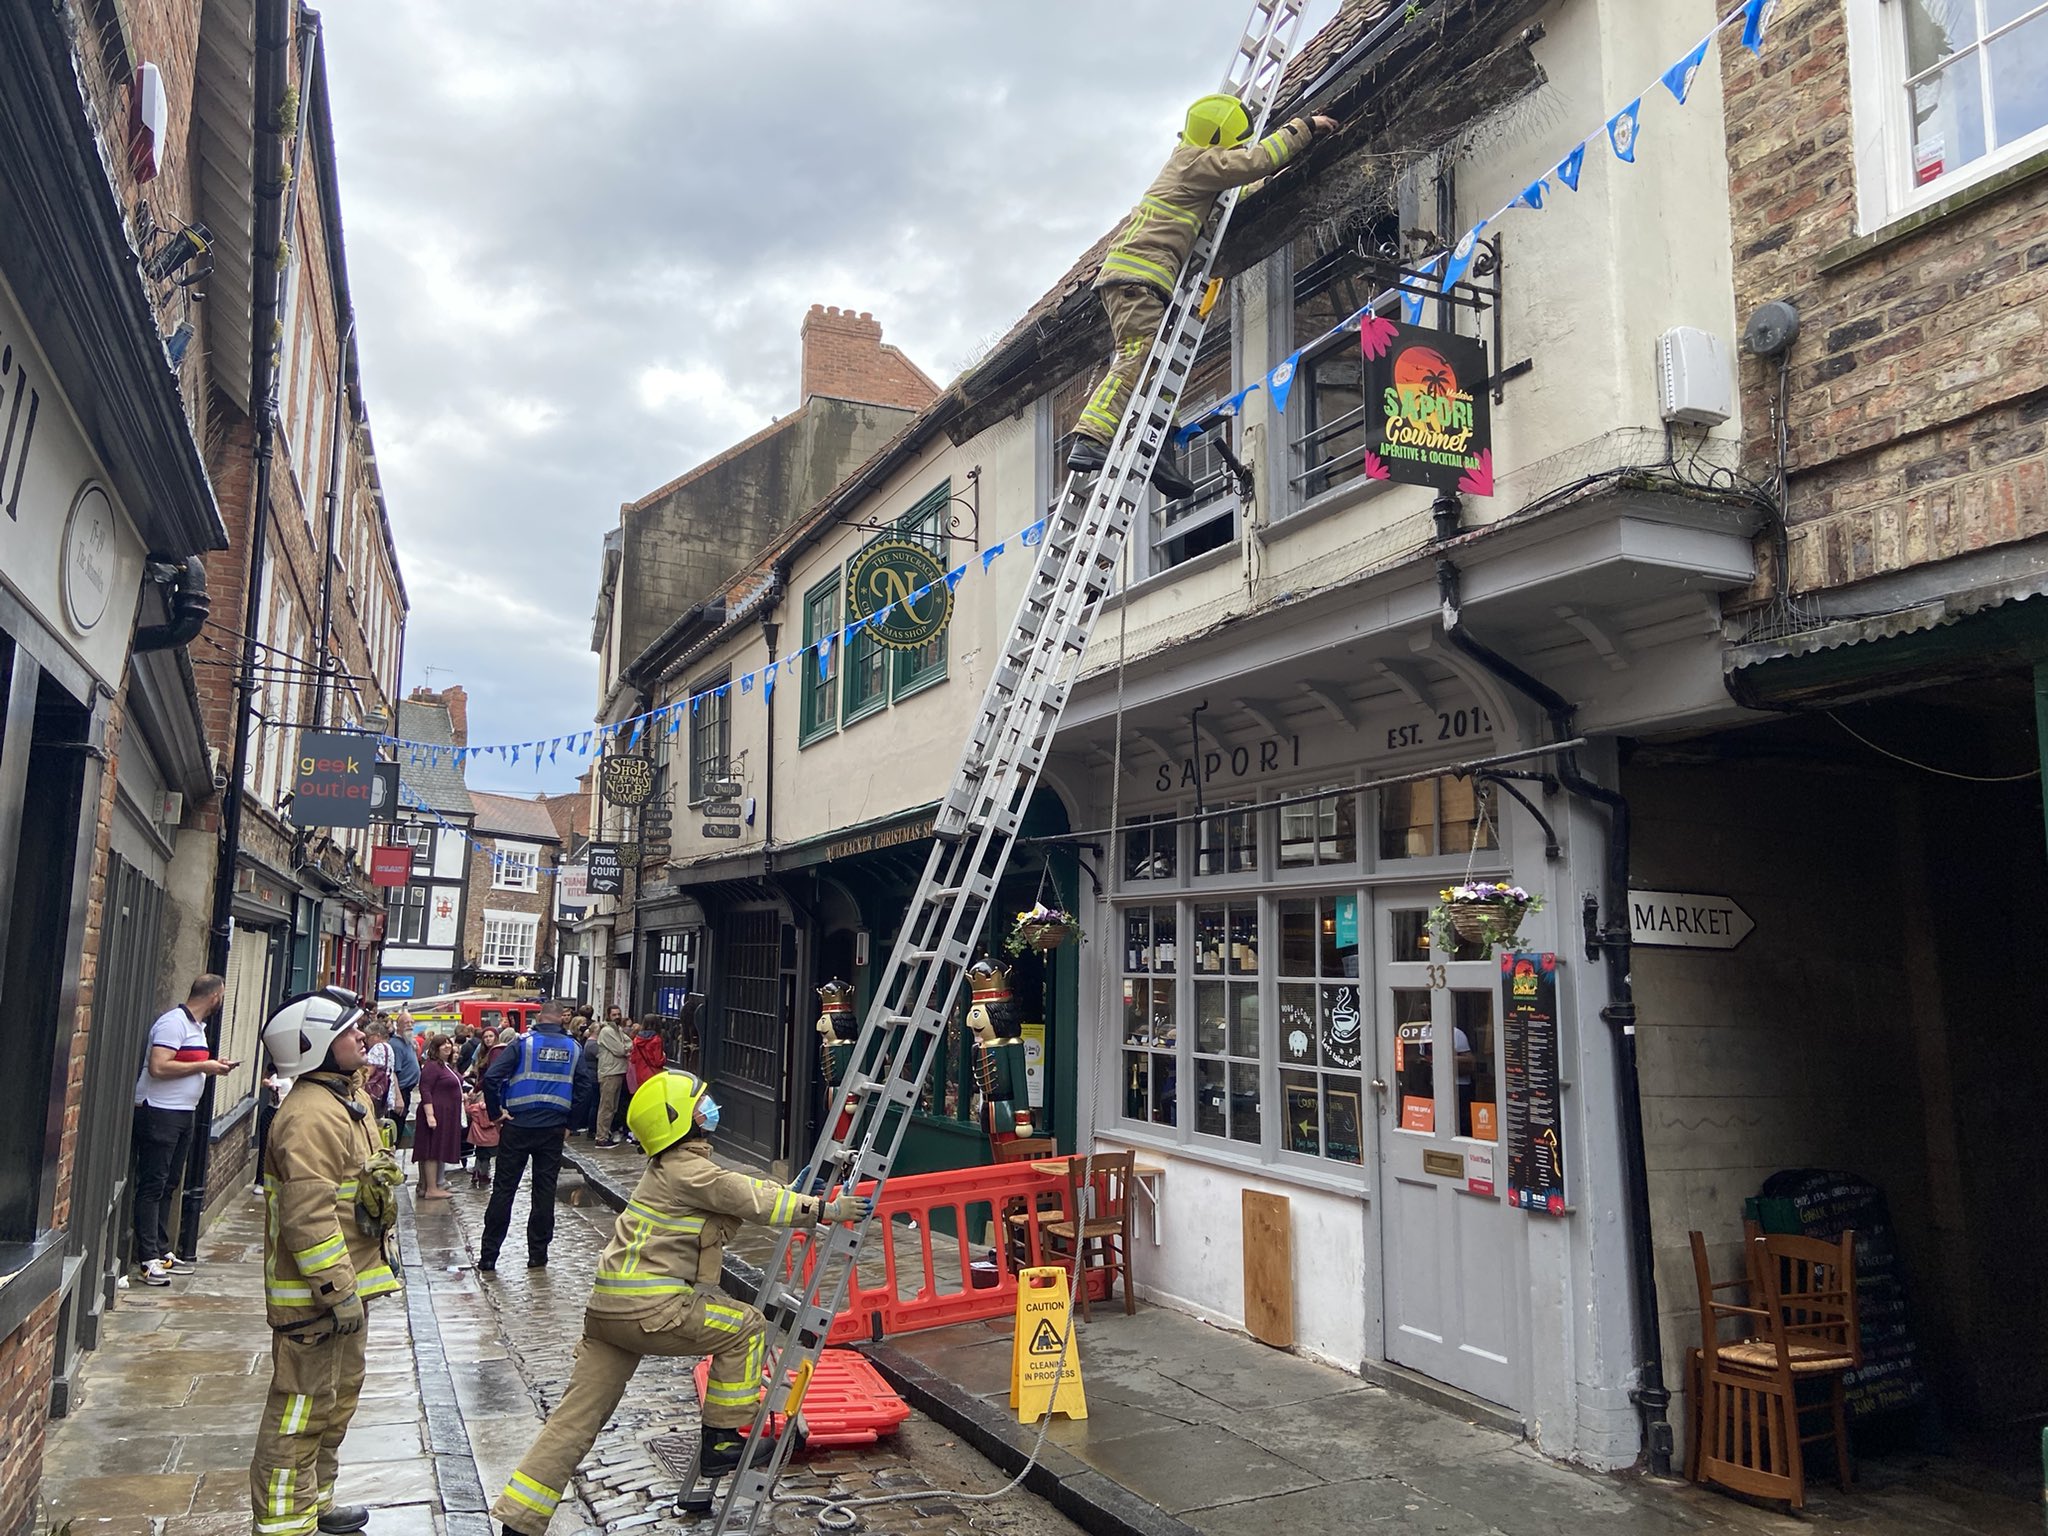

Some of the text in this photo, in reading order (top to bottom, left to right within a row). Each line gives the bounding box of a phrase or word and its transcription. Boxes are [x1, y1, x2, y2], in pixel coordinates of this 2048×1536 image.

[1384, 387, 1474, 430] SAPORI
[1386, 416, 1474, 453] Gourmet
[1380, 442, 1481, 470] APERITIVE & COCKTAIL BAR
[871, 554, 891, 568] THE
[870, 567, 933, 625] N
[904, 625, 928, 638] SHOP
[1387, 723, 1423, 749] EST.
[300, 756, 360, 776] geek
[610, 758, 648, 776] SHOP
[1156, 735, 1299, 791] SAPORI
[300, 775, 370, 800] outlet
[606, 780, 651, 796] NOT BE
[610, 793, 644, 804] NAMED
[874, 823, 920, 849] CHRISTMAS
[923, 820, 935, 838] SH
[595, 856, 617, 866] FOOD
[590, 866, 621, 877] COURT
[1634, 903, 1733, 935] MARKET
[374, 979, 410, 993] GGS
[1426, 964, 1447, 990] 33
[1026, 1301, 1065, 1312] CAUTION
[1030, 1359, 1067, 1370] CLEANING
[1024, 1369, 1075, 1381] IN PROGESS
